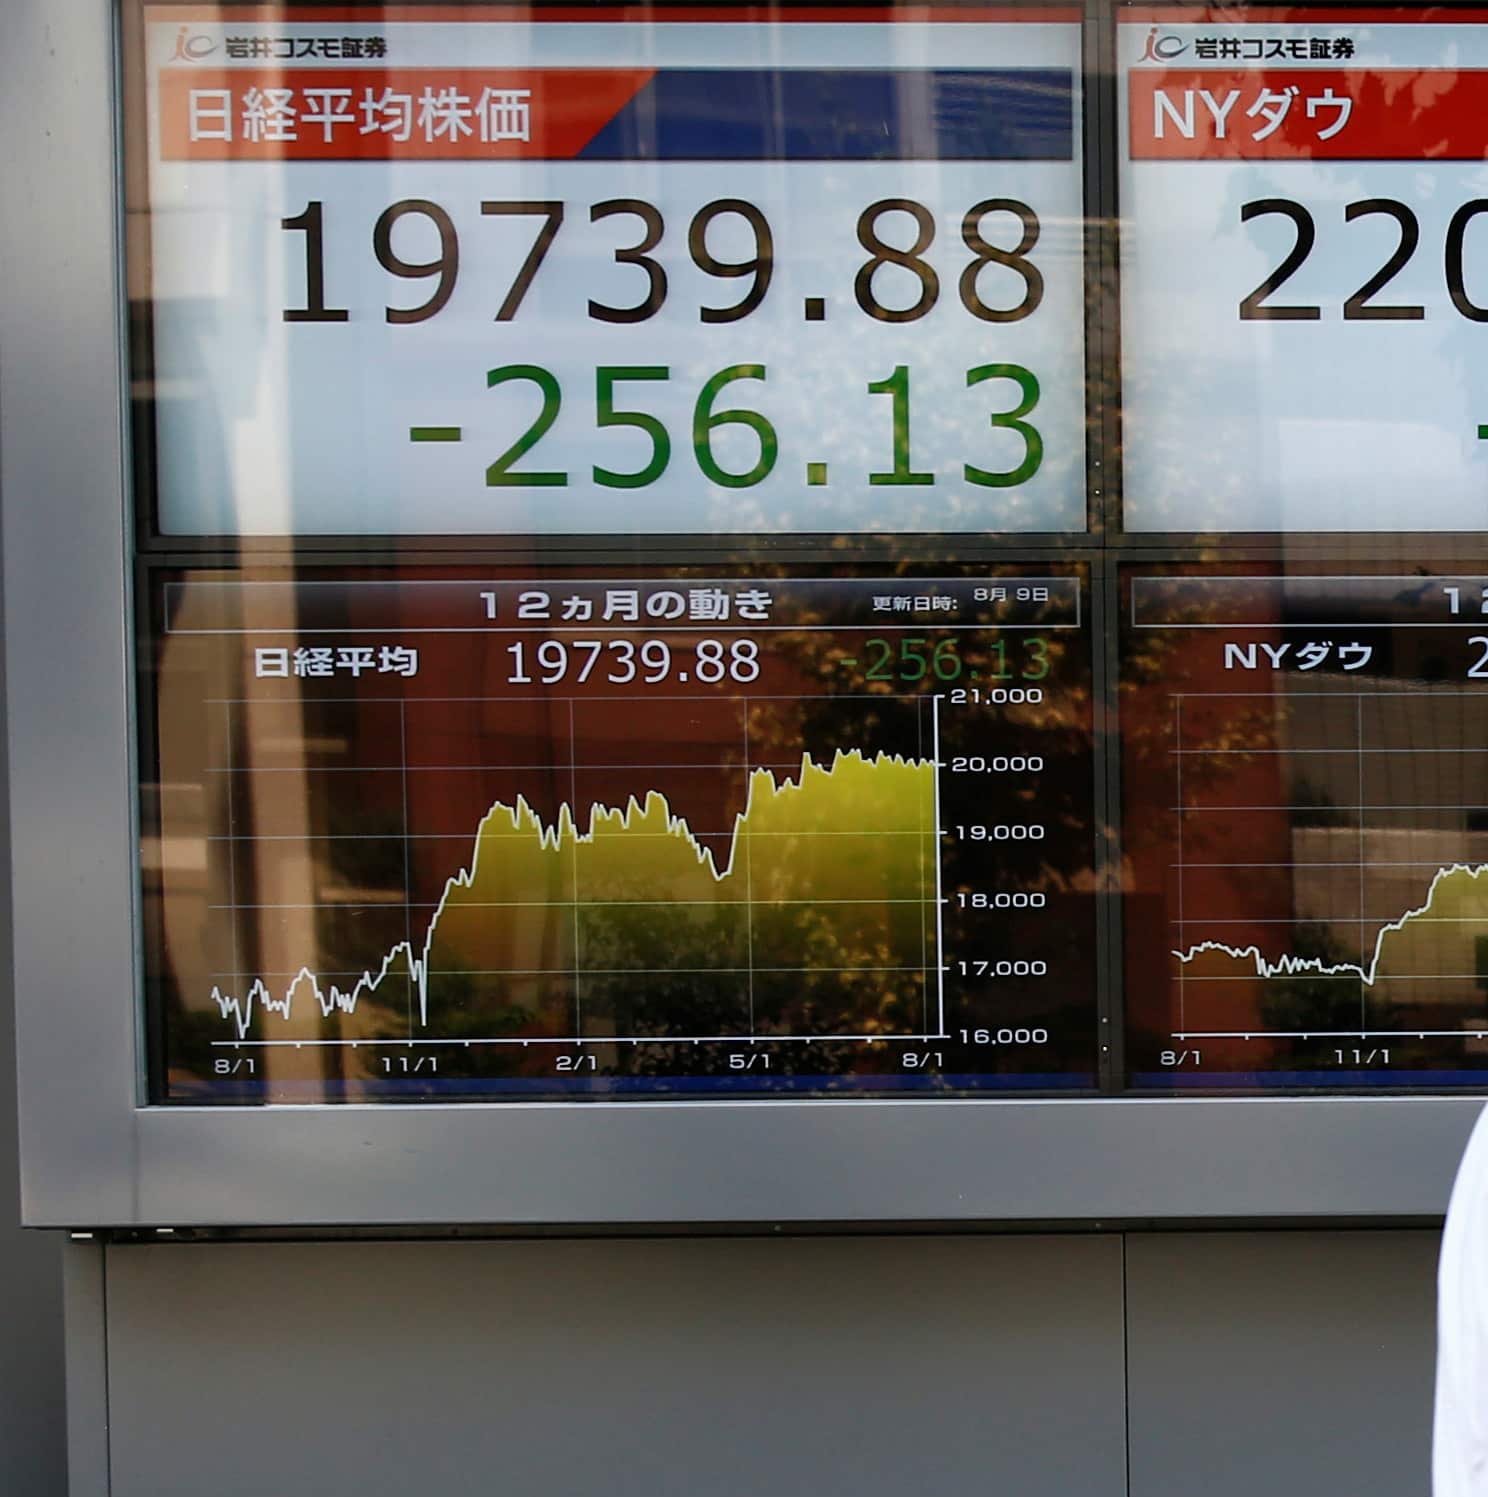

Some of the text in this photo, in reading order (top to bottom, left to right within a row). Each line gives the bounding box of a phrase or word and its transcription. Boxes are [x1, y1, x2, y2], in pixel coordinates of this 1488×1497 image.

[226, 34, 387, 61] 岩井コスモ証券
[1194, 37, 1355, 60] 岩井コスモ証券
[187, 86, 531, 144] 日経平均株価
[1153, 87, 1353, 140] NYダウ
[281, 198, 1045, 325] 19739.88
[409, 364, 1044, 488] -256.13
[254, 638, 1049, 684] 日経平均 19739.88 -256.13
[1223, 641, 1373, 670] NYダウ
[950, 688, 1042, 706] 21,000
[951, 757, 1044, 774] 20,000
[956, 825, 1045, 842] 19,000
[957, 893, 1046, 910] 18,000
[958, 961, 1047, 978] 17,000
[959, 1029, 1048, 1045] 16,000
[382, 1056, 438, 1073] 11/1
[555, 1055, 597, 1071] 2/1
[729, 1053, 770, 1069] 5/1
[902, 1052, 943, 1068] 8/1
[1160, 1050, 1200, 1066] 8/1
[1334, 1049, 1391, 1065] 11/1
[214, 1058, 255, 1074] 8/1
